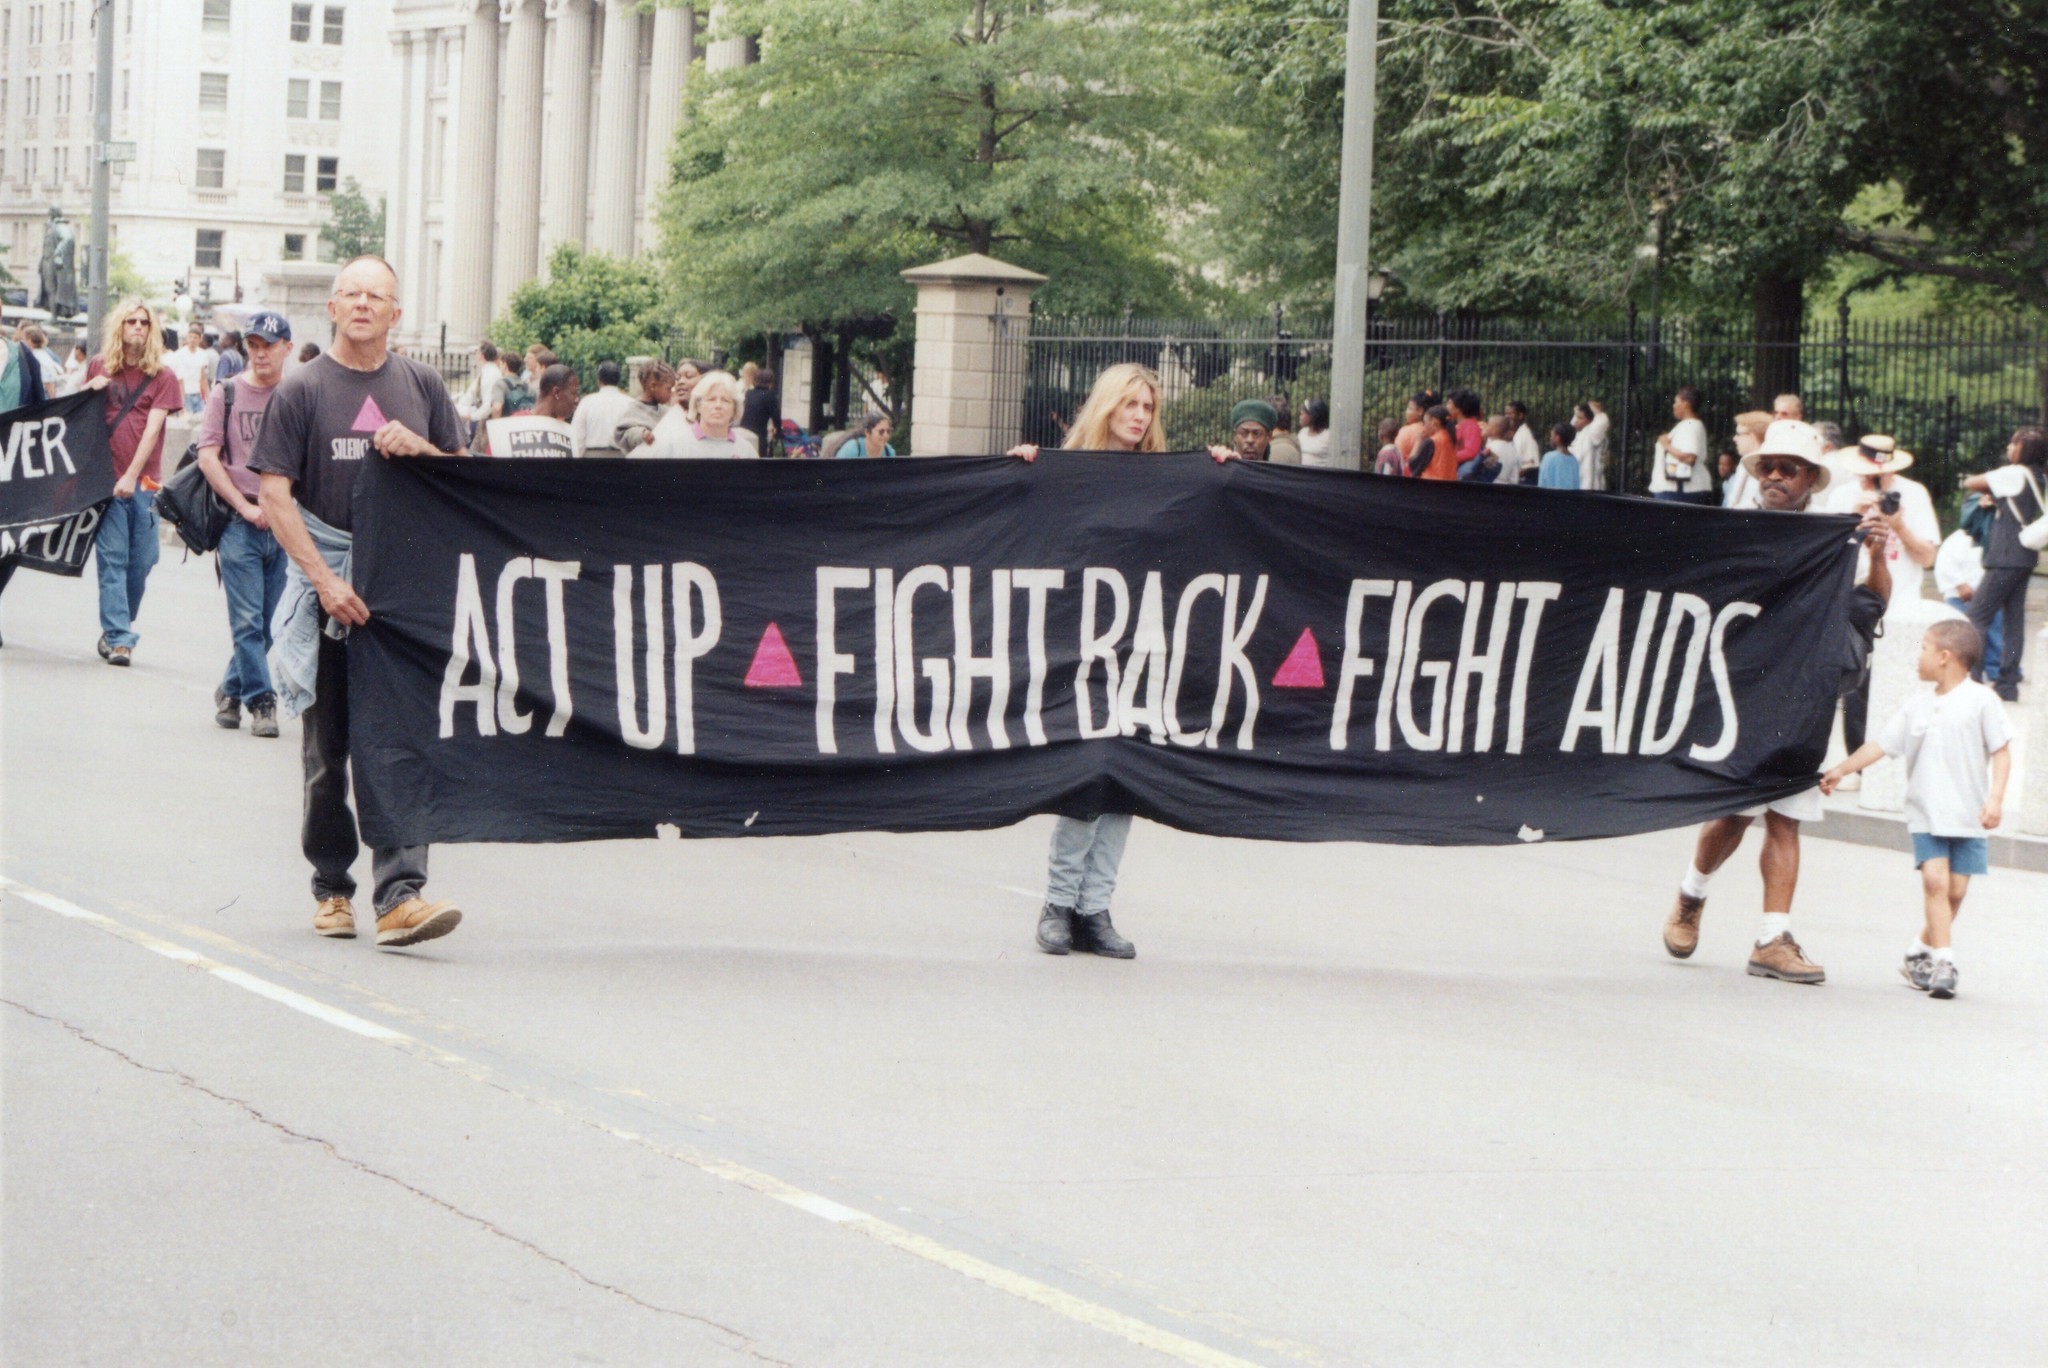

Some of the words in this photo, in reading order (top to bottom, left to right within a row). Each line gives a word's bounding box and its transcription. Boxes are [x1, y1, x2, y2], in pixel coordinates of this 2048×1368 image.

[511, 431, 544, 445] HEY
[439, 554, 580, 738] ACT
[613, 562, 722, 754] UP
[816, 565, 1064, 753] FIGHT
[1075, 567, 1268, 750] BACK
[1330, 579, 1561, 754] FIGHT
[1560, 588, 1761, 762] AIDS
